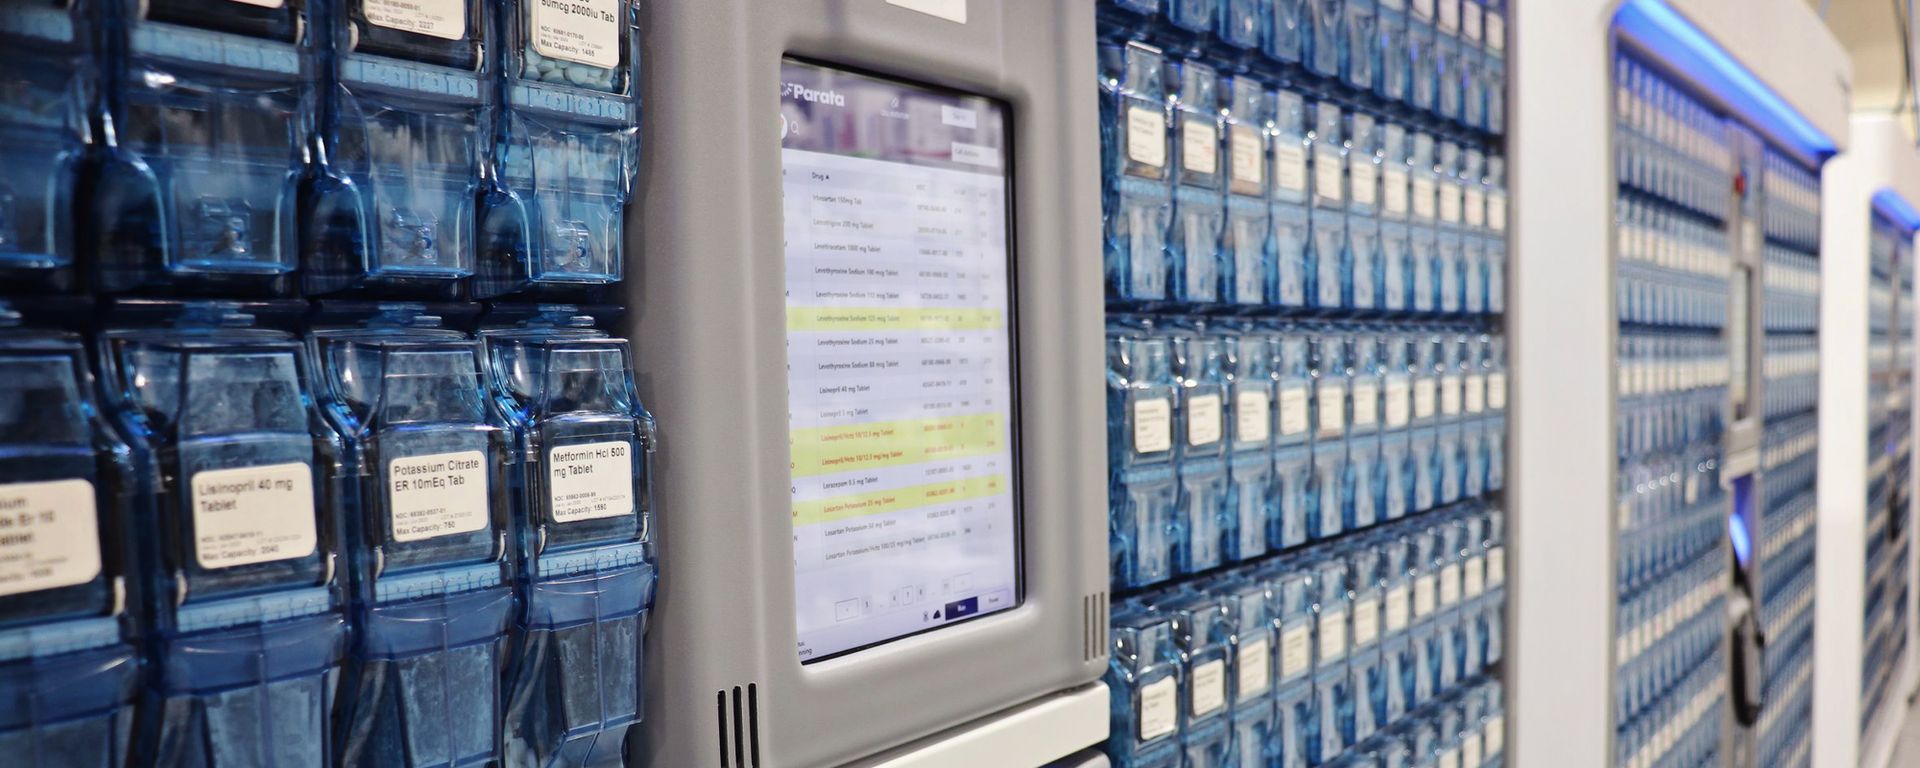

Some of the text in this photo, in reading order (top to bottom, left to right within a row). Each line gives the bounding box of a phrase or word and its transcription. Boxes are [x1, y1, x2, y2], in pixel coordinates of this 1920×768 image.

[600, 10, 615, 23] Tab
[541, 40, 552, 48] Max
[793, 84, 845, 106] Parata
[553, 450, 594, 462] Metformin
[611, 447, 625, 457] 500
[394, 459, 480, 476] Potassium Citrate
[554, 464, 593, 478] mg Tablet
[199, 478, 294, 496] Lisinopril 40 mg
[395, 474, 465, 492] ER 10mEq Tab
[200, 499, 238, 512] Tablet
